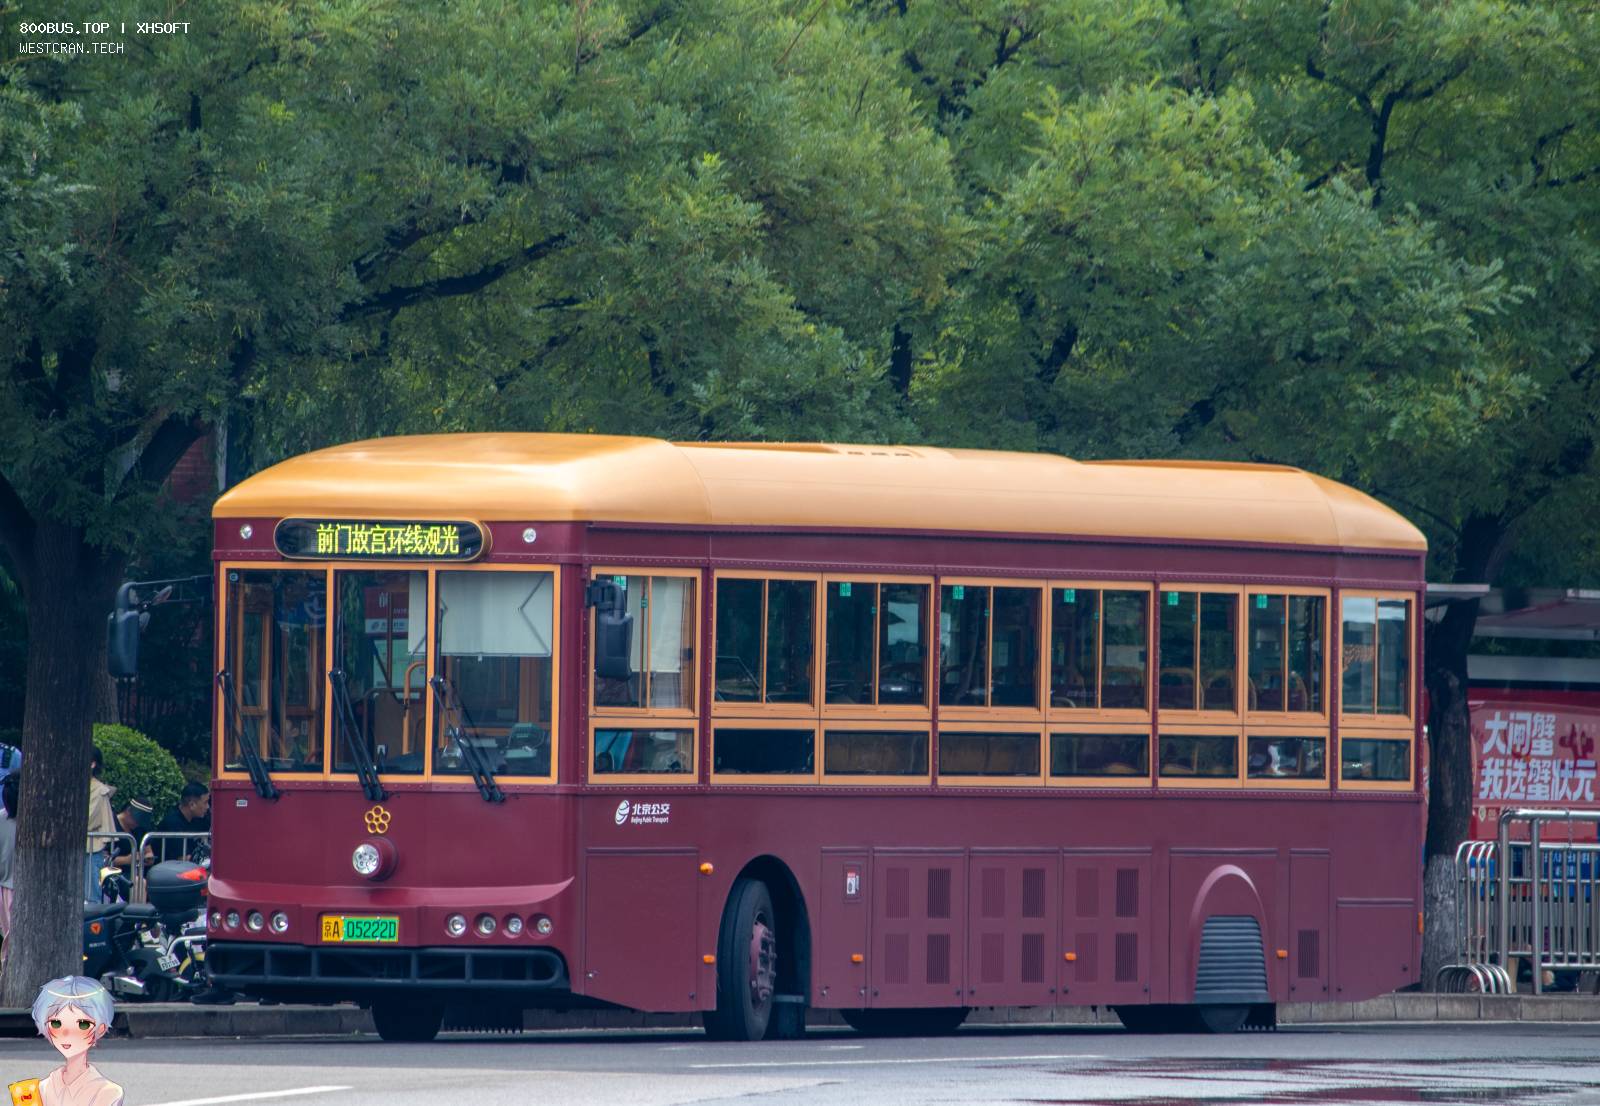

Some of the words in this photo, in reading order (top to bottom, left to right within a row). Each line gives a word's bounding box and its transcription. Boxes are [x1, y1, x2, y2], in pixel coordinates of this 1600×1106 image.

[316, 523, 459, 555] 前门故宫环线观光
[1479, 757, 1597, 802] 我选蟹状元
[631, 803, 671, 816] 北京公交
